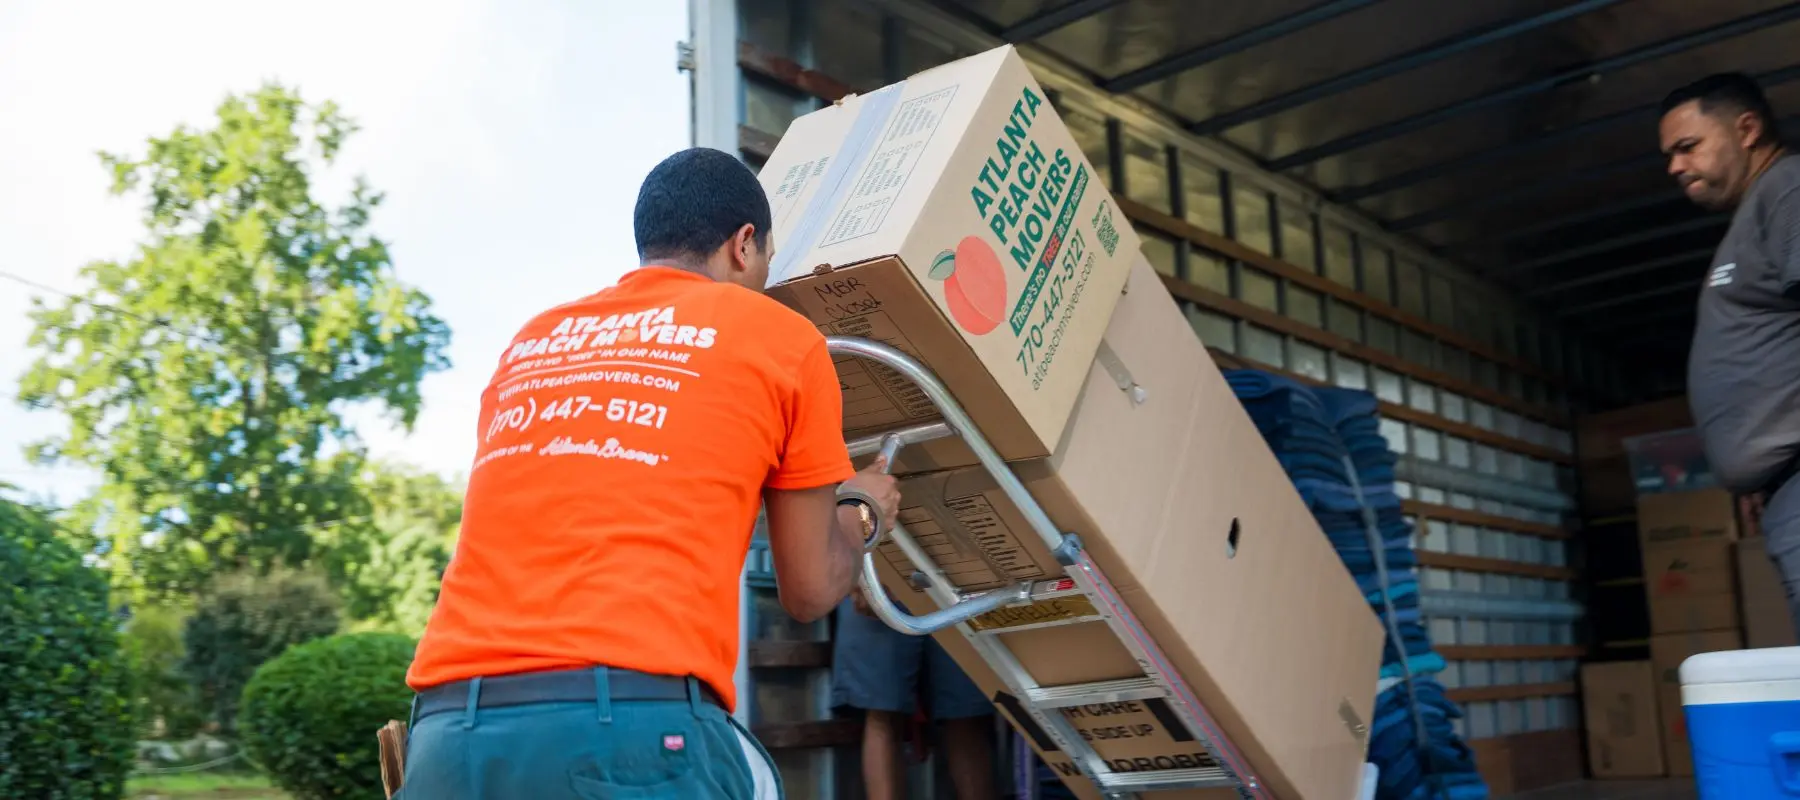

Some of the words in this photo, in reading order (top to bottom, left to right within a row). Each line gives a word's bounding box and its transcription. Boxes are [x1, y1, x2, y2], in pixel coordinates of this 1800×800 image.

[970, 86, 1042, 219] ATLANTA
[989, 140, 1047, 245] PEACH
[1009, 148, 1072, 272] MOVERS
[813, 276, 866, 303] MBR
[1011, 284, 1038, 329] There's
[1035, 268, 1046, 287] no
[1041, 232, 1061, 268] TREE
[1056, 223, 1066, 239] in
[551, 305, 675, 337] ATLANTA
[1016, 228, 1086, 376] 770-447-5121
[1031, 251, 1097, 391] atlpeachmovers.com
[507, 333, 588, 363] PEACH
[600, 348, 616, 358] IN
[617, 348, 648, 358] OUR
[648, 349, 691, 364] NAME
[486, 397, 536, 442] (770)
[540, 396, 668, 429] 447-5121
[1085, 699, 1144, 716] CARE
[1091, 725, 1133, 740] SIDE
[1128, 723, 1154, 737] UP
[1051, 752, 1217, 777] WDROBE
